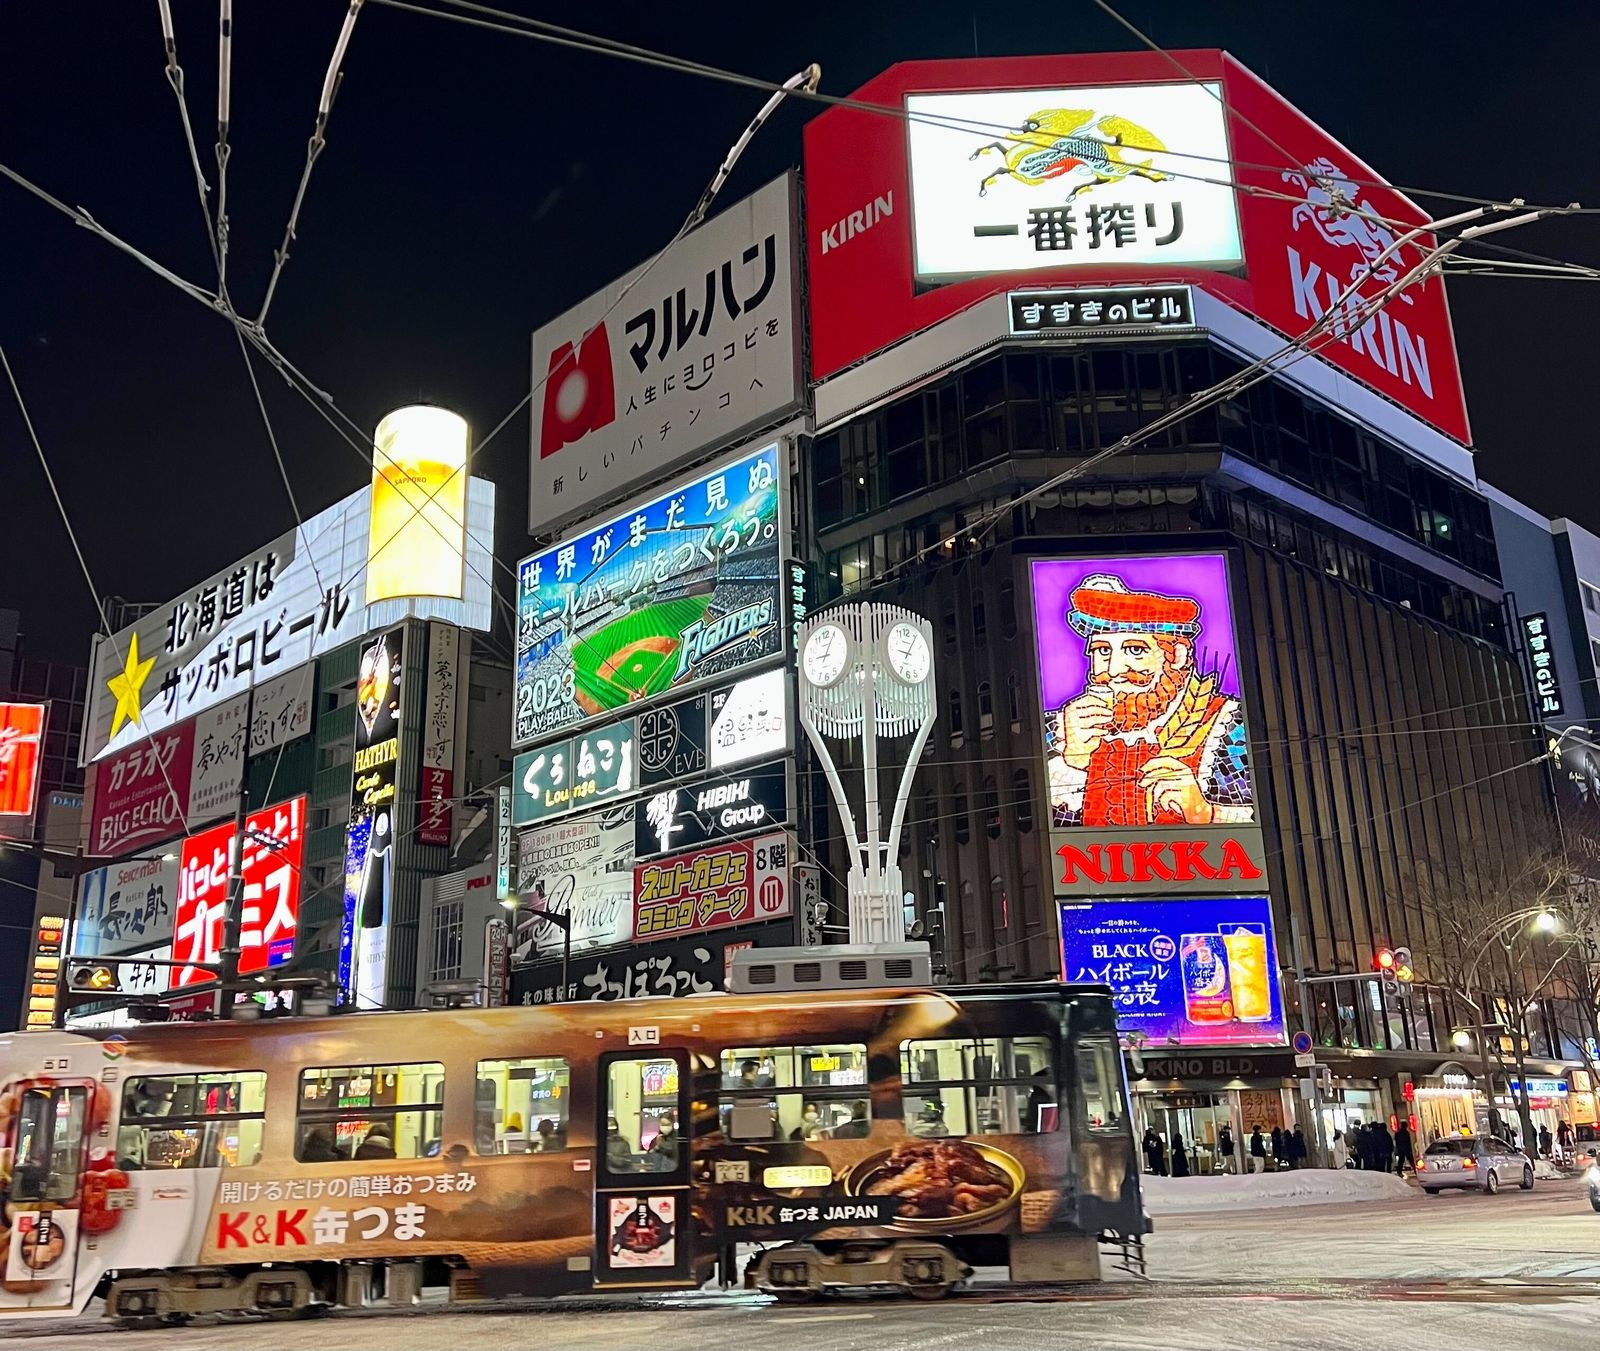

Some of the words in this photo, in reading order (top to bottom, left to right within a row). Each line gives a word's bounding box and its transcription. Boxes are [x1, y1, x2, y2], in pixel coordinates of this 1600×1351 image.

[822, 190, 894, 255] KIRIN
[974, 201, 1184, 251] 一番搾り
[625, 234, 776, 374] マルハン
[1020, 296, 1181, 326] すすきのビル
[1287, 245, 1434, 400] KIRIN
[626, 318, 778, 416] 人生にヨロコビを
[553, 378, 763, 496] 新しいパチンコへ
[523, 458, 773, 596] 世界がまだ見ぬ
[522, 510, 774, 634] ボールパークをつくろう。
[165, 552, 277, 654] 北海道は
[160, 583, 349, 715] サッポロビール
[672, 596, 774, 683] FIGHTERS
[1527, 618, 1560, 712] すすきのビル
[518, 668, 577, 720] 2023
[108, 735, 181, 793] カラオケ
[355, 738, 398, 773] HATHYR
[523, 740, 615, 800] くろねこ
[674, 748, 705, 775] EVE
[429, 770, 448, 829] カラオケ
[545, 780, 596, 808] Lounge
[697, 779, 750, 811] HIBIKI
[720, 804, 765, 828] Group
[100, 808, 130, 851] BIG
[131, 791, 179, 829] ECHO
[639, 851, 748, 902] ネットカフェ
[756, 844, 787, 871] 8階
[1056, 838, 1263, 884] NIKKA
[100, 882, 168, 941] 長次郎
[177, 863, 298, 988] プロミス
[638, 897, 695, 936] コミック
[699, 888, 748, 926] ダーツ
[583, 948, 713, 1000] さっぽろっこ
[1075, 962, 1171, 981] ハイボール
[1091, 944, 1149, 959] BLACK
[1112, 981, 1161, 1006] る夜
[631, 1030, 657, 1041] 入口
[1147, 1059, 1203, 1077] KINO
[1212, 1058, 1260, 1075] BLD.
[220, 1172, 477, 1204] 開けるだけの簡単おつまみ
[217, 1208, 310, 1249] K&K
[312, 1202, 427, 1245] 缶つま
[727, 1206, 775, 1227] K&K
[779, 1207, 819, 1223] 缶つま
[823, 1205, 879, 1221] JAPAN
